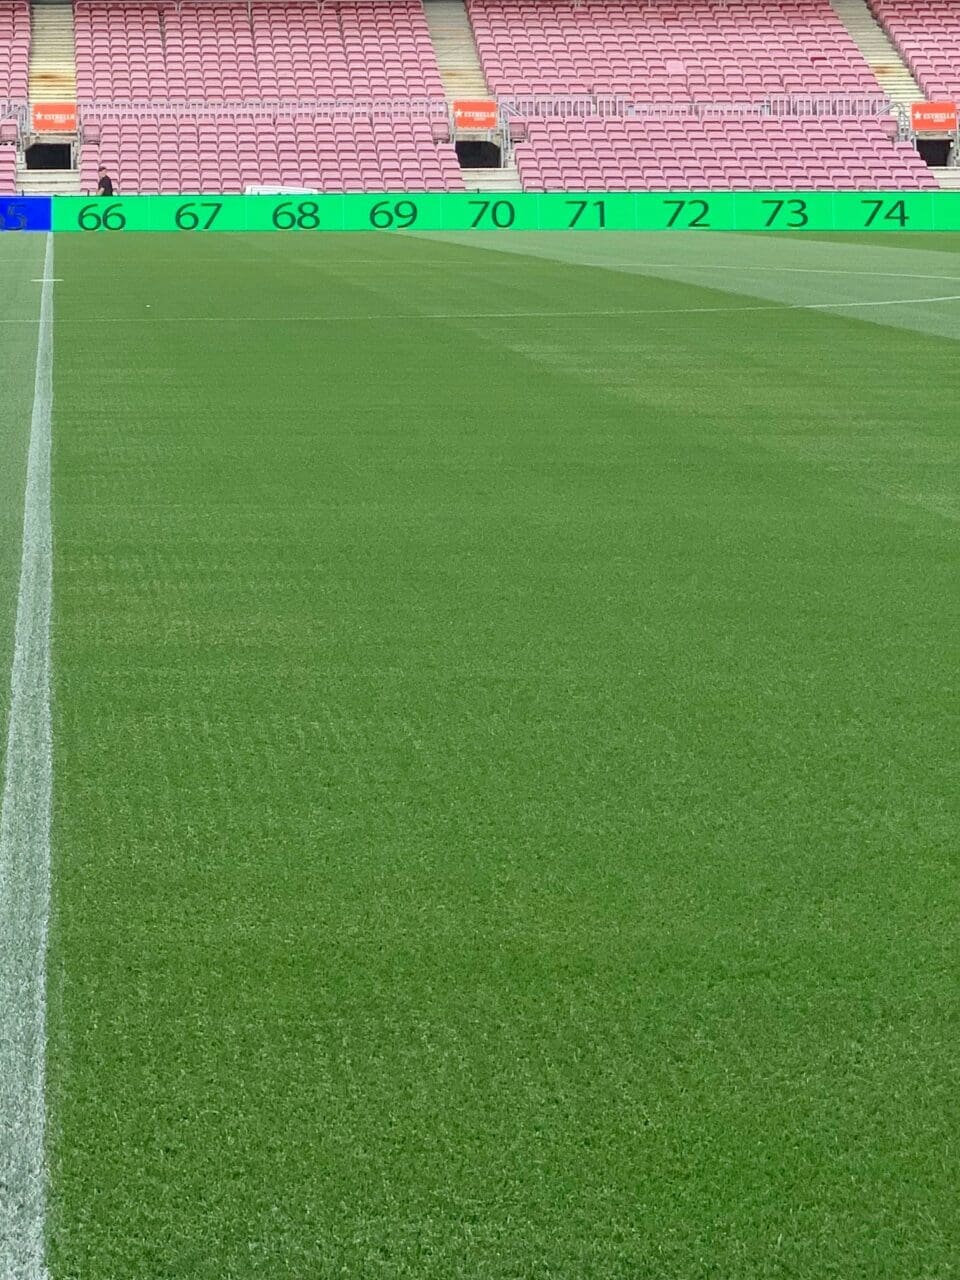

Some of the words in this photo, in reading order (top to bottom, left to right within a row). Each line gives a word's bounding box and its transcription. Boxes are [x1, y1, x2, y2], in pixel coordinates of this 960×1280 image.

[923, 112, 954, 120] ESTRELLA
[78, 203, 125, 231] 66
[175, 203, 222, 230] 67
[272, 202, 320, 230] 68
[369, 201, 417, 229] 69
[468, 200, 515, 228] 70
[565, 200, 606, 228] 71
[662, 200, 710, 228] 72
[761, 200, 808, 227] 73
[861, 200, 909, 227] 74
